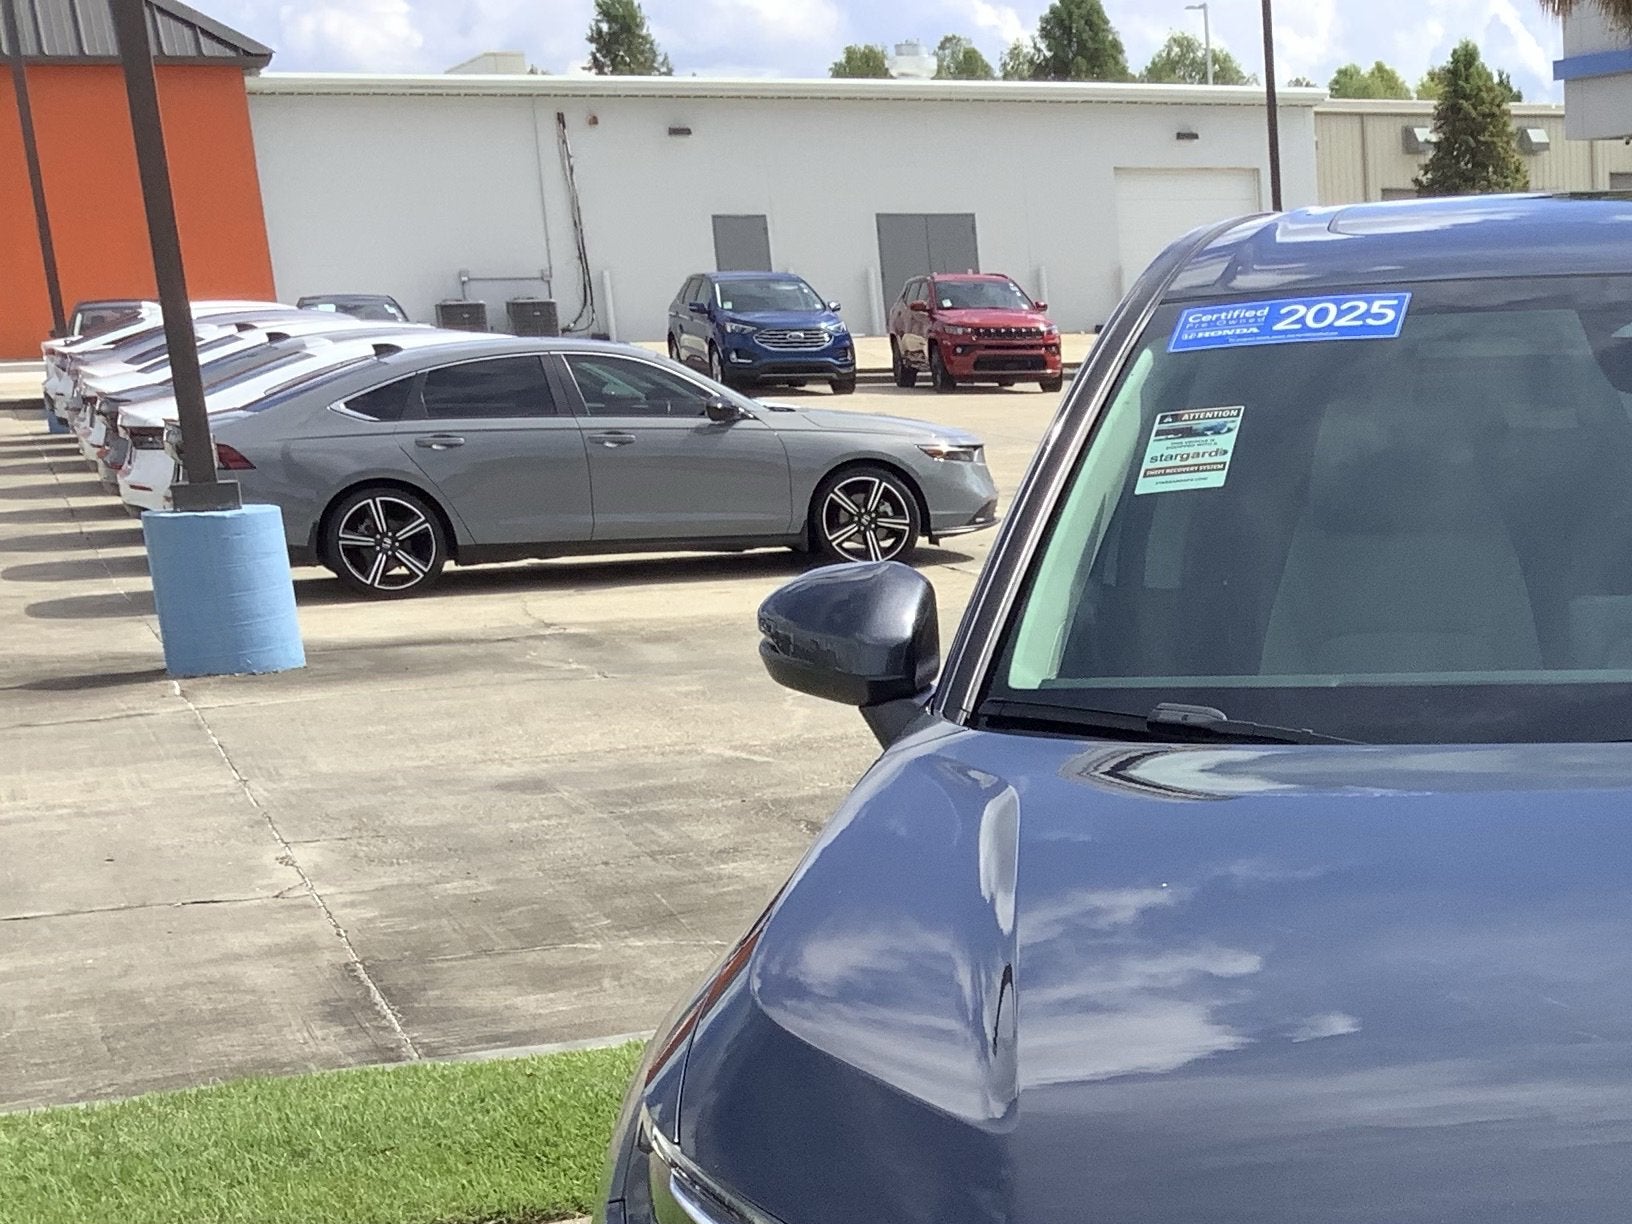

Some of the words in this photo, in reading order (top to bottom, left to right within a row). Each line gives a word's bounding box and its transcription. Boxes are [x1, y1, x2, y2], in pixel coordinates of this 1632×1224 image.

[1188, 306, 1270, 323] Certified
[1271, 300, 1399, 331] 2025
[1197, 327, 1261, 338] HONDA
[1181, 409, 1239, 421] ATTENTION
